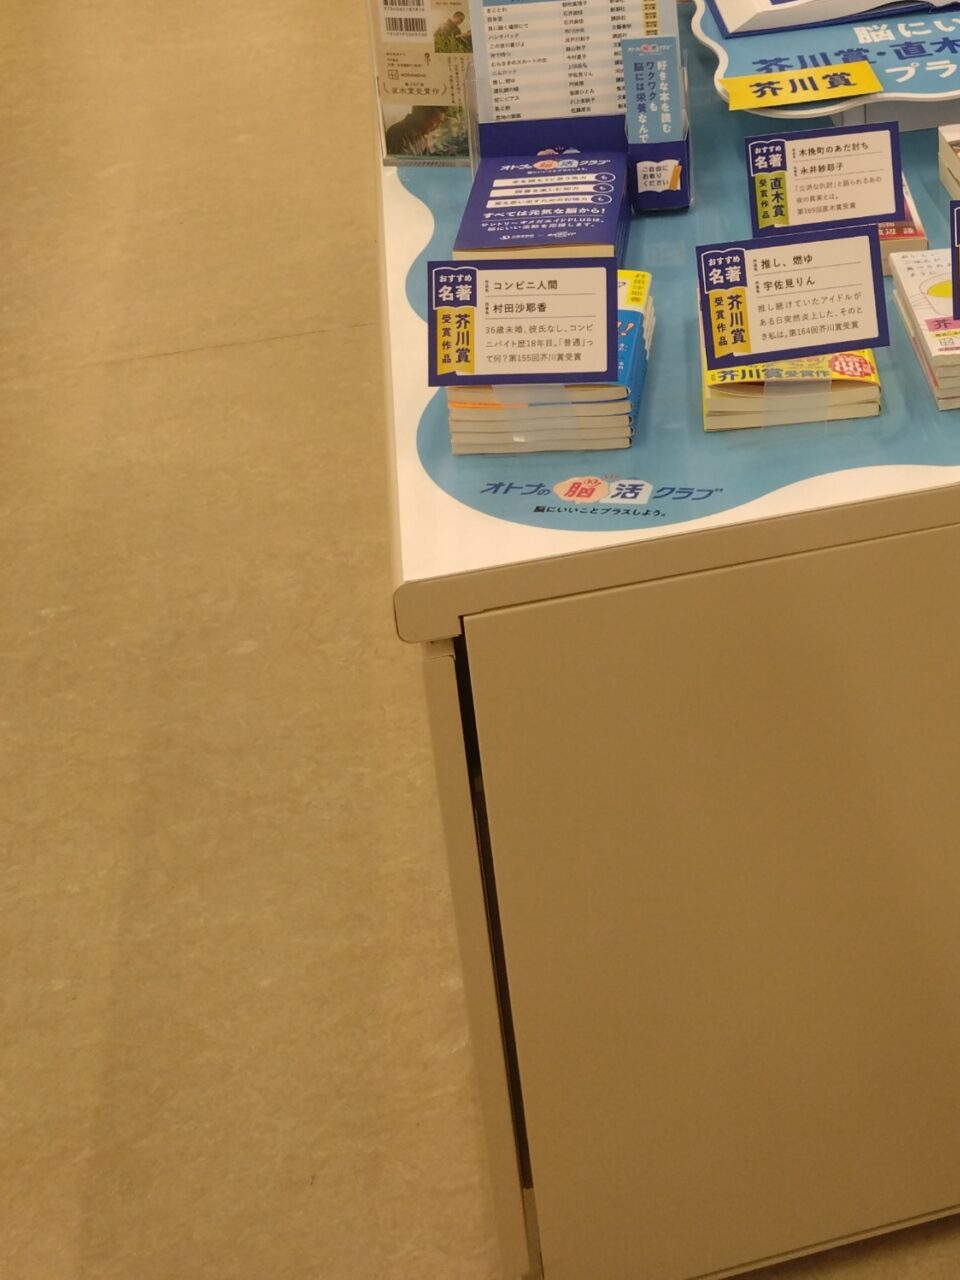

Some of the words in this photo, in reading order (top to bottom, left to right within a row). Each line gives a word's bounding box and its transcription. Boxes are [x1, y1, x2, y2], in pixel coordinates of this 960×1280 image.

[646, 61, 658, 112] ワクワクも
[749, 71, 858, 98] 芥川賞
[754, 145, 782, 155] おすすめ
[798, 141, 869, 157] 木挽町のあだ討ち
[754, 154, 783, 169] 名著
[642, 179, 669, 188] ください
[759, 179, 770, 220] 受賞作品
[770, 177, 786, 218] 直木賞
[708, 255, 741, 266] おすすめ
[761, 254, 813, 270] 推し、燃ゆ
[439, 273, 473, 283] おすすめ
[708, 265, 742, 284] 名著
[493, 280, 558, 291] コンビニ人間
[763, 278, 815, 291] 宇佐見りん
[438, 285, 473, 302] 名著
[493, 302, 547, 313] 村田沙耶香
[757, 291, 862, 313] 推し続けていたアイドルが
[714, 296, 728, 347] 受賞作品
[727, 294, 746, 345] 芥川賞
[441, 314, 452, 365] 受賞作品
[455, 313, 471, 365] 芥川賞
[532, 505, 666, 517] 脳にいいことプラスしよう。
